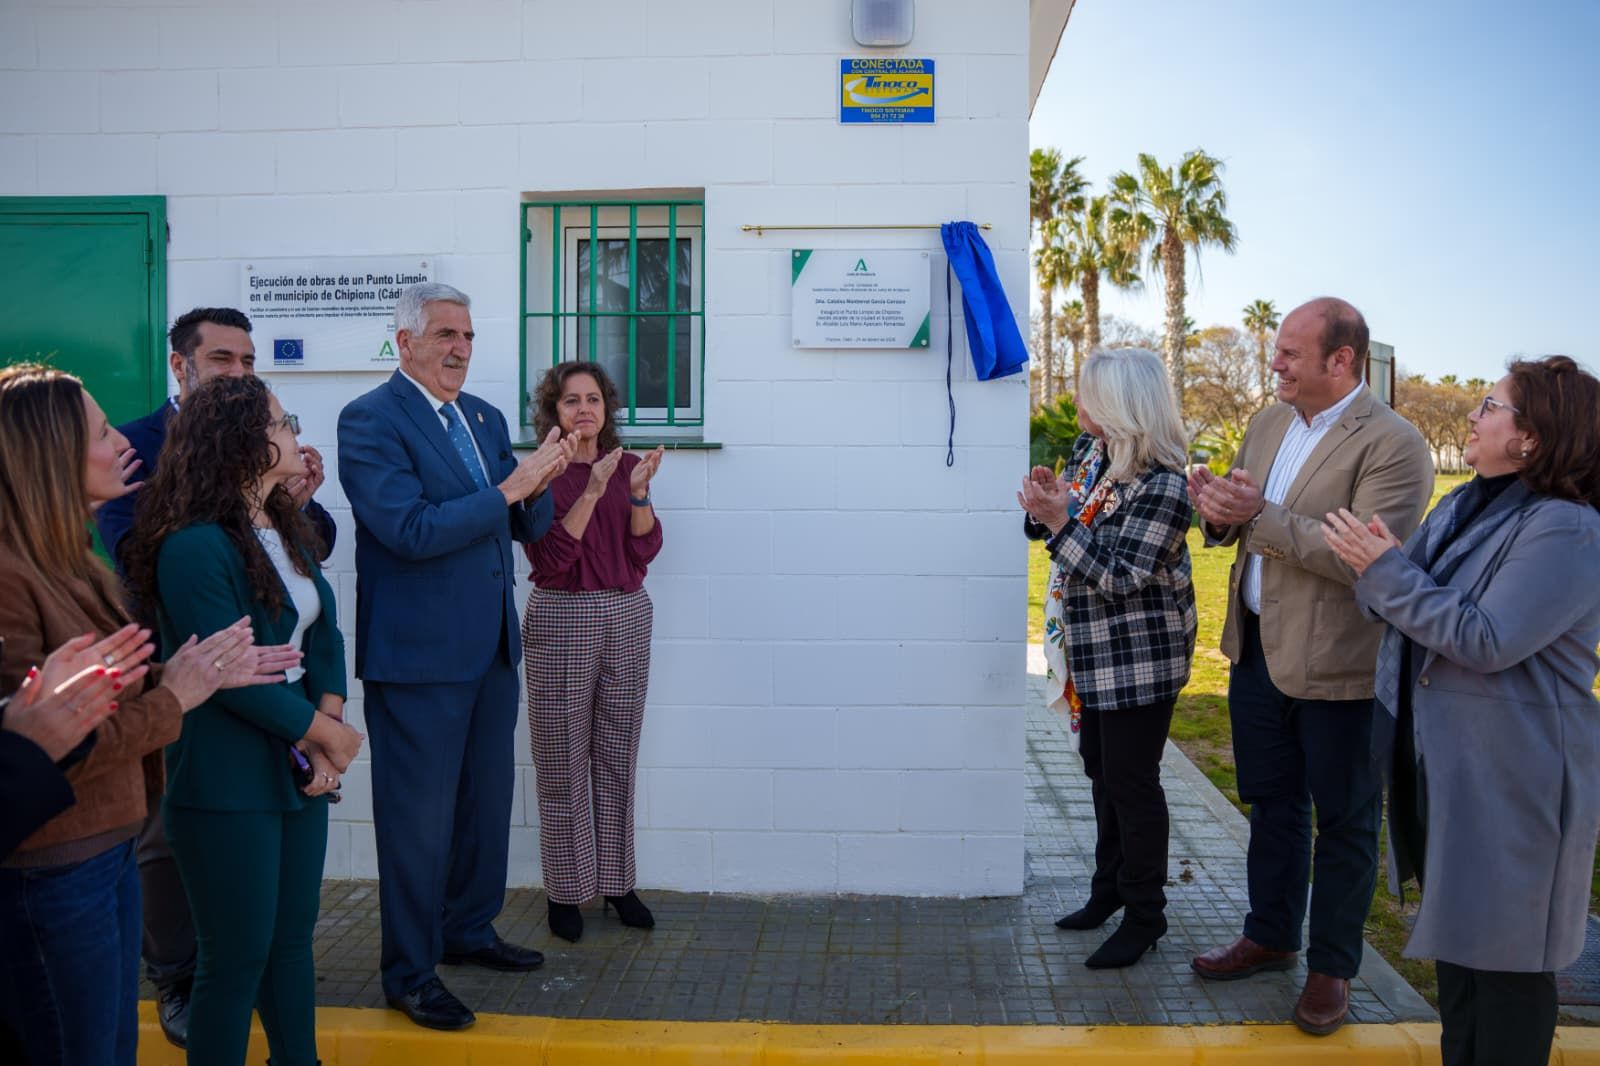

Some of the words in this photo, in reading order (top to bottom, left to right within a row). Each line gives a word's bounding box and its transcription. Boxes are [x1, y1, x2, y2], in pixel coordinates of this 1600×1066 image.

[851, 59, 924, 69] CONECTADA
[250, 276, 294, 289] Ejecución
[296, 275, 307, 286] de
[310, 274, 336, 286] obras
[338, 274, 349, 285] de
[352, 276, 364, 285] un
[366, 274, 394, 285] Punto
[250, 293, 261, 302] en
[263, 290, 272, 301] el
[274, 290, 318, 303] municipio
[321, 289, 332, 300] de
[335, 288, 375, 302] Chipiona
